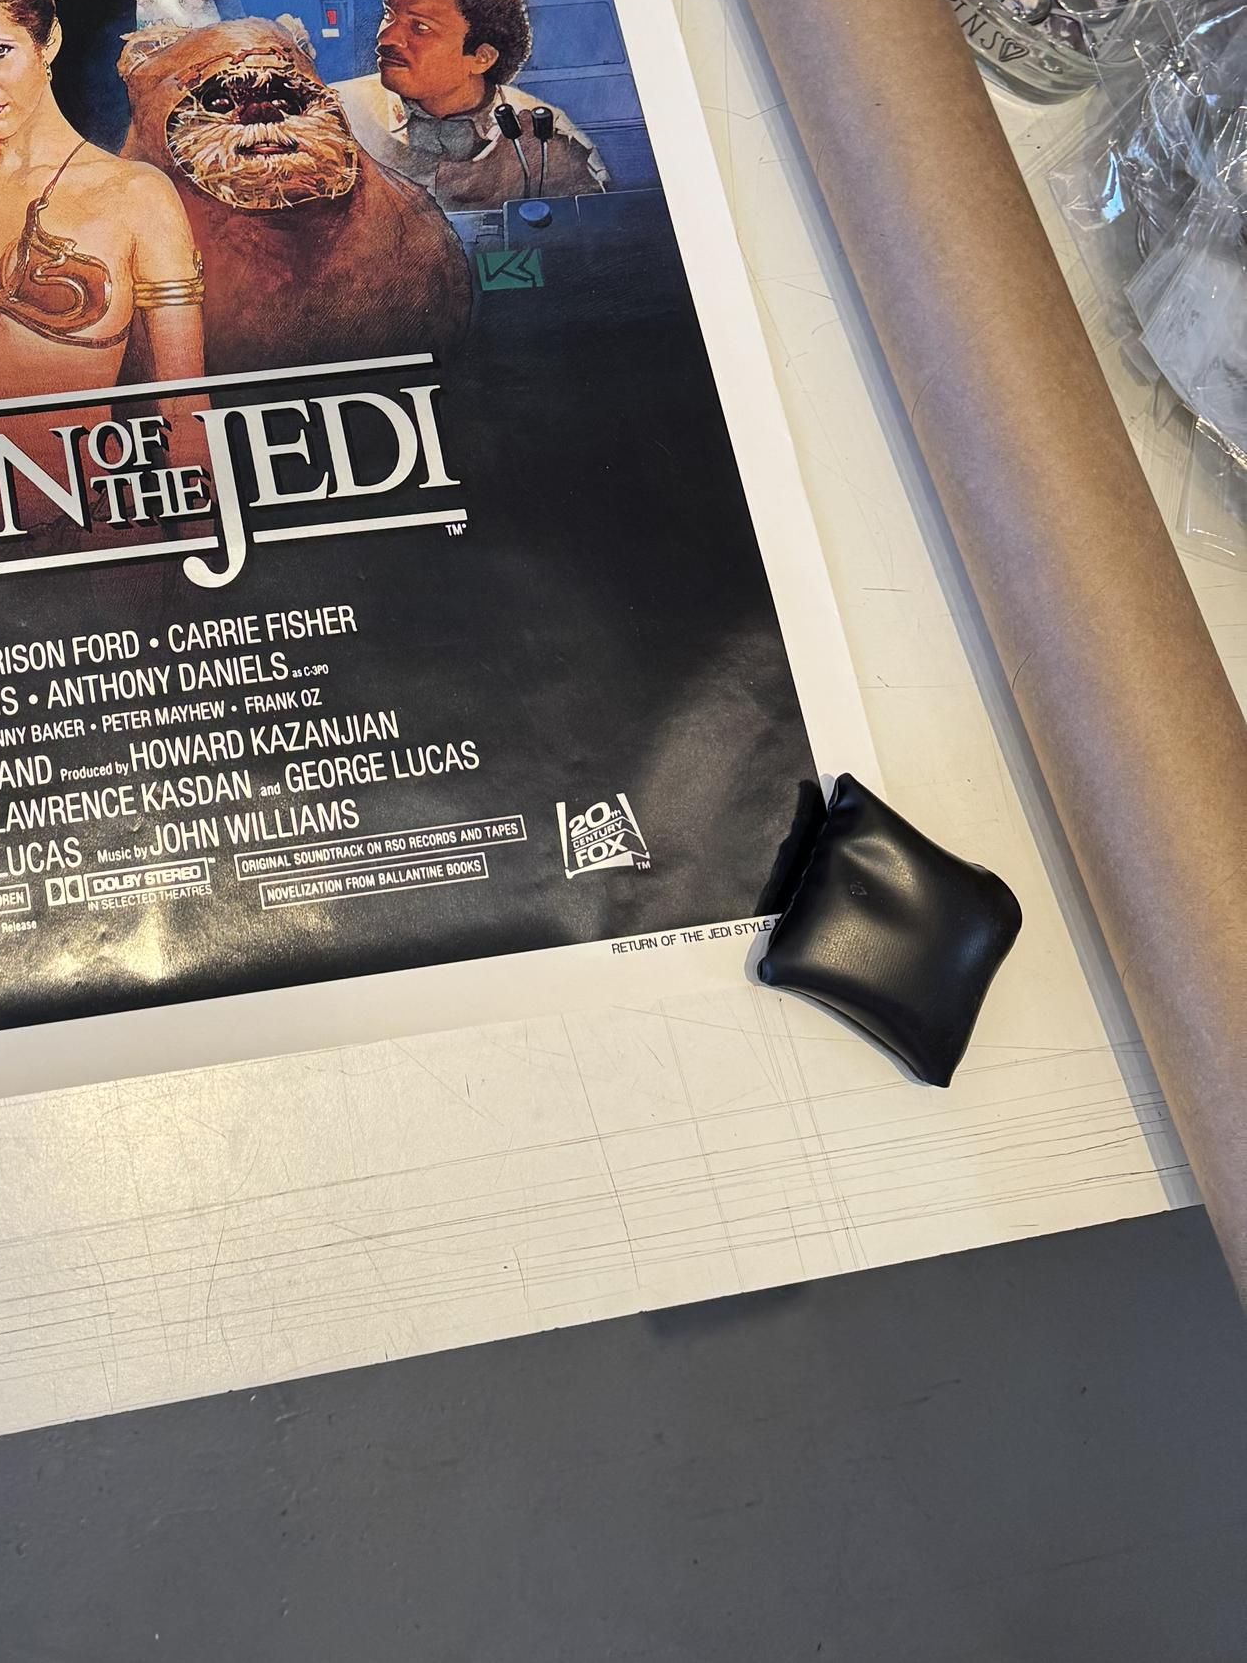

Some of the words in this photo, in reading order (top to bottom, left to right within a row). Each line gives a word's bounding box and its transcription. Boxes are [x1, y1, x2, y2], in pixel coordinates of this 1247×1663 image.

[88, 415, 166, 470] OF
[90, 465, 212, 525] THE
[183, 384, 461, 589] JEDI
[72, 630, 140, 666] FORD
[168, 615, 261, 653] CARRIE
[265, 604, 358, 643] FISHER
[47, 665, 171, 710] ANTHONY
[179, 651, 289, 692] DANIELS
[292, 669, 303, 679] as
[30, 718, 85, 744] BAKER
[102, 708, 152, 733] PETER
[155, 700, 225, 727] MAYHEW
[244, 690, 298, 715] FRANK
[301, 688, 323, 708] OZ
[60, 761, 113, 783] Produced
[115, 760, 129, 777] by
[129, 728, 245, 772] HOWARD
[250, 710, 400, 757] KAZANJIAN
[142, 769, 253, 813] KASDAN
[260, 782, 281, 798] and
[285, 752, 388, 793] GEORGE
[391, 739, 481, 778] LUCAS
[97, 847, 132, 864] Music
[133, 844, 148, 860] by
[149, 817, 220, 857] JOHN
[224, 798, 360, 845] WILLIAMS
[241, 854, 291, 873] ORIGINAL
[294, 844, 364, 866] SOUNDTRACK
[366, 841, 382, 855] ON
[384, 837, 406, 852] RSO
[408, 830, 457, 849] RECORDS
[459, 826, 482, 842] AND
[484, 822, 518, 839] TAPES
[572, 821, 624, 849] CENTURY
[575, 834, 629, 869] FOX
[92, 875, 143, 894] DOLBY
[144, 865, 202, 887] STEREO
[266, 880, 343, 903] NOVELIZATION
[346, 873, 375, 890] FROM
[378, 865, 444, 886] BALLANTINE
[446, 859, 481, 877] BOOKS
[1, 918, 38, 936] Release
[611, 937, 658, 955] RETURN
[661, 934, 677, 947] OF
[680, 929, 704, 944] THE
[708, 925, 733, 941] JEDI
[734, 918, 773, 936] STYLE
